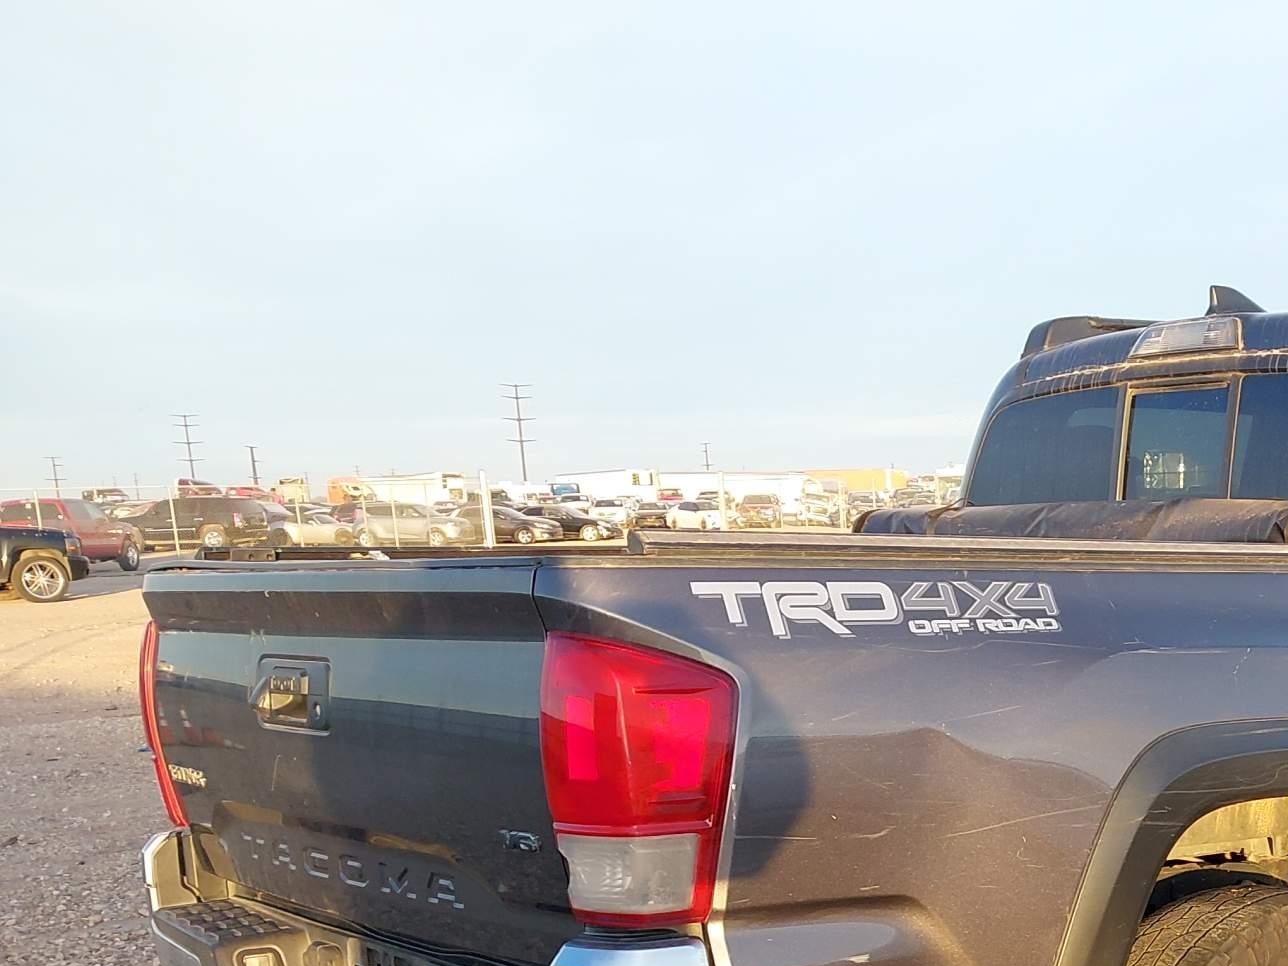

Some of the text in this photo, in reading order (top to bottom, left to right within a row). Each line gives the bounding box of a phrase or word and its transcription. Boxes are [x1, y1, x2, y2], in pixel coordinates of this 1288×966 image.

[690, 581, 901, 639] TRD
[908, 618, 1062, 635] OFF ROAD
[238, 831, 465, 910] TACOMA
